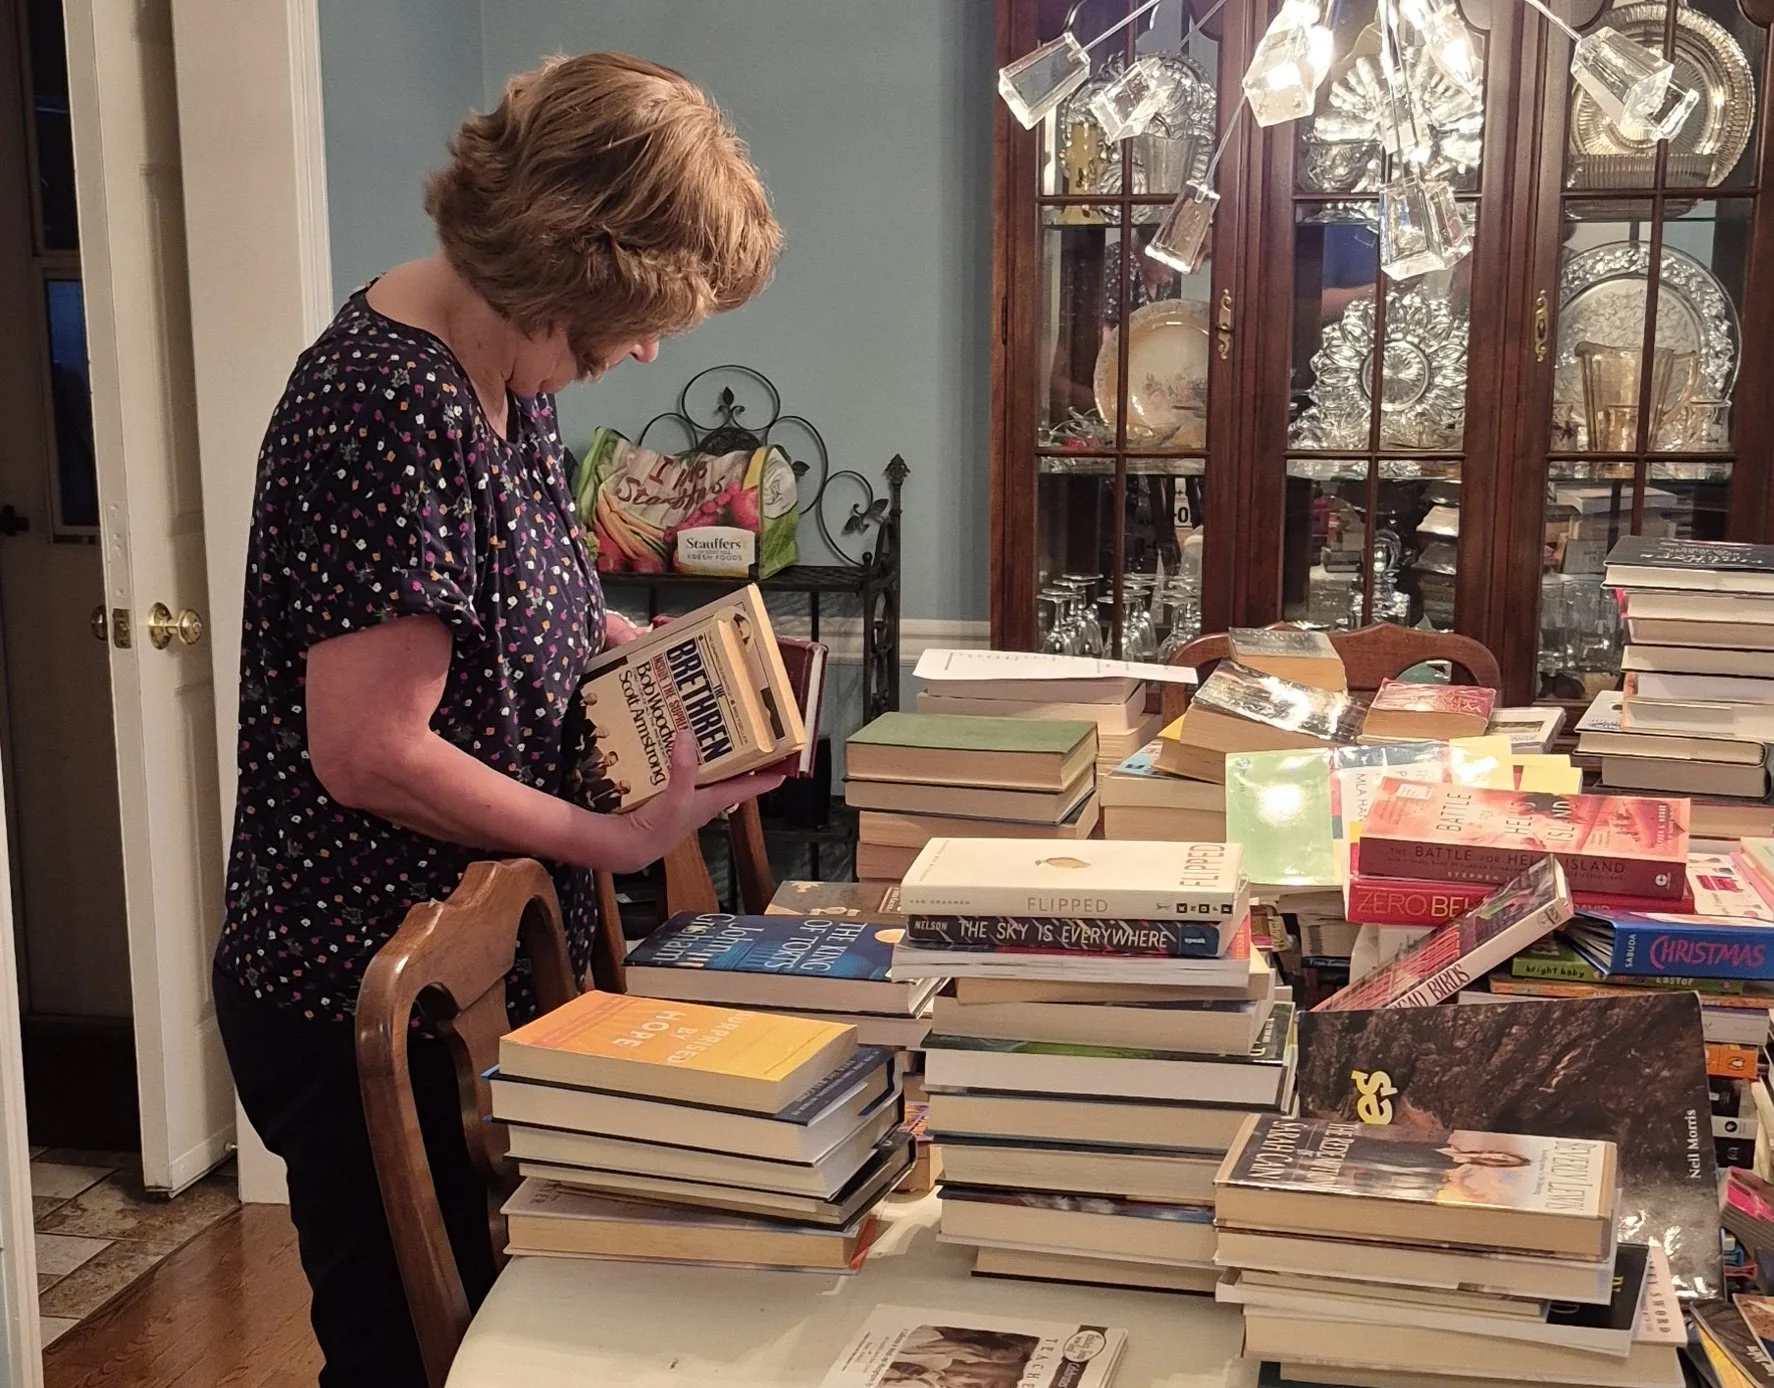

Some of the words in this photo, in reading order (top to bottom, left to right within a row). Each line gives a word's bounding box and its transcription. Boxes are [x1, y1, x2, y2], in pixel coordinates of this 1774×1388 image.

[686, 537, 742, 550] Stauffers
[634, 661, 660, 698] Bob
[652, 653, 671, 684] INSIDE
[616, 669, 643, 708] Scott
[662, 681, 677, 700] THE
[664, 638, 735, 763] BRETHREN
[713, 684, 726, 699] THE
[646, 692, 682, 759] Woodwa
[669, 699, 689, 733] SUPRE
[626, 705, 669, 787] Armstrong
[1355, 772, 1367, 796] MLA
[1436, 792, 1472, 833] BATTLE
[1179, 844, 1226, 887] FLIPPED
[1415, 846, 1473, 861] BATTLE
[1566, 858, 1626, 874] ISLAND
[1448, 871, 1500, 881] STEPHEN
[1027, 897, 1109, 913] FLIPPED
[1357, 892, 1428, 915] ZERO
[1431, 895, 1473, 917] BEL
[652, 913, 737, 963] Grisham
[704, 925, 765, 957] John
[804, 918, 834, 937] OF
[838, 921, 869, 943] THE
[914, 920, 948, 931] NELSON
[958, 919, 989, 938] THE
[996, 922, 1030, 940] SKY
[1037, 924, 1054, 942] IS
[1061, 926, 1169, 949] EVERYWHERE
[763, 935, 819, 971] TORTS
[799, 943, 848, 974] KING
[1624, 933, 1637, 968] SABUDA
[1650, 935, 1768, 971] CHRISTMAS
[1388, 990, 1430, 1009] EAD
[1426, 963, 1471, 1001] BIRDS
[1525, 964, 1558, 977] bright
[1560, 967, 1585, 979] baby
[612, 1008, 689, 1050] HOPE
[677, 1025, 699, 1042] BY
[1351, 1069, 1398, 1125] es
[1260, 1119, 1308, 1153] SARAH
[1324, 1122, 1360, 1137] THE
[1688, 1109, 1698, 1150] Morris
[1248, 1152, 1294, 1180] CAIN
[1551, 1140, 1598, 1181] BEVERLY
[1689, 1152, 1702, 1179] Neil
[1545, 1180, 1594, 1211] LEWIS
